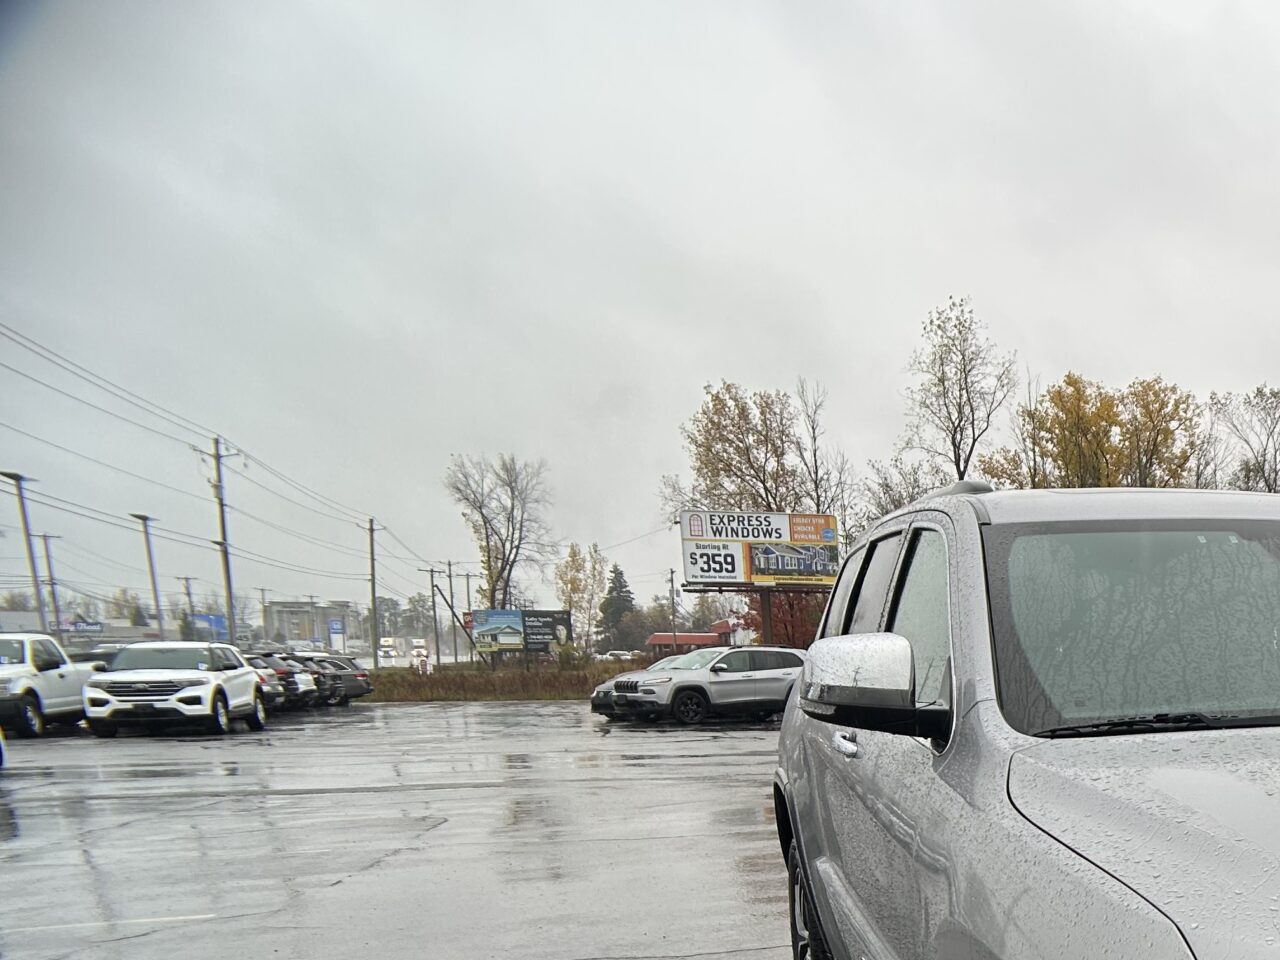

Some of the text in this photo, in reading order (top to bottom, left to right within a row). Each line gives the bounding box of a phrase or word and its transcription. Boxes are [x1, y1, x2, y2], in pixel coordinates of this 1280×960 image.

[709, 514, 772, 527] EXPRESS
[711, 526, 782, 539] WINDOWS
[695, 543, 721, 551] Starting
